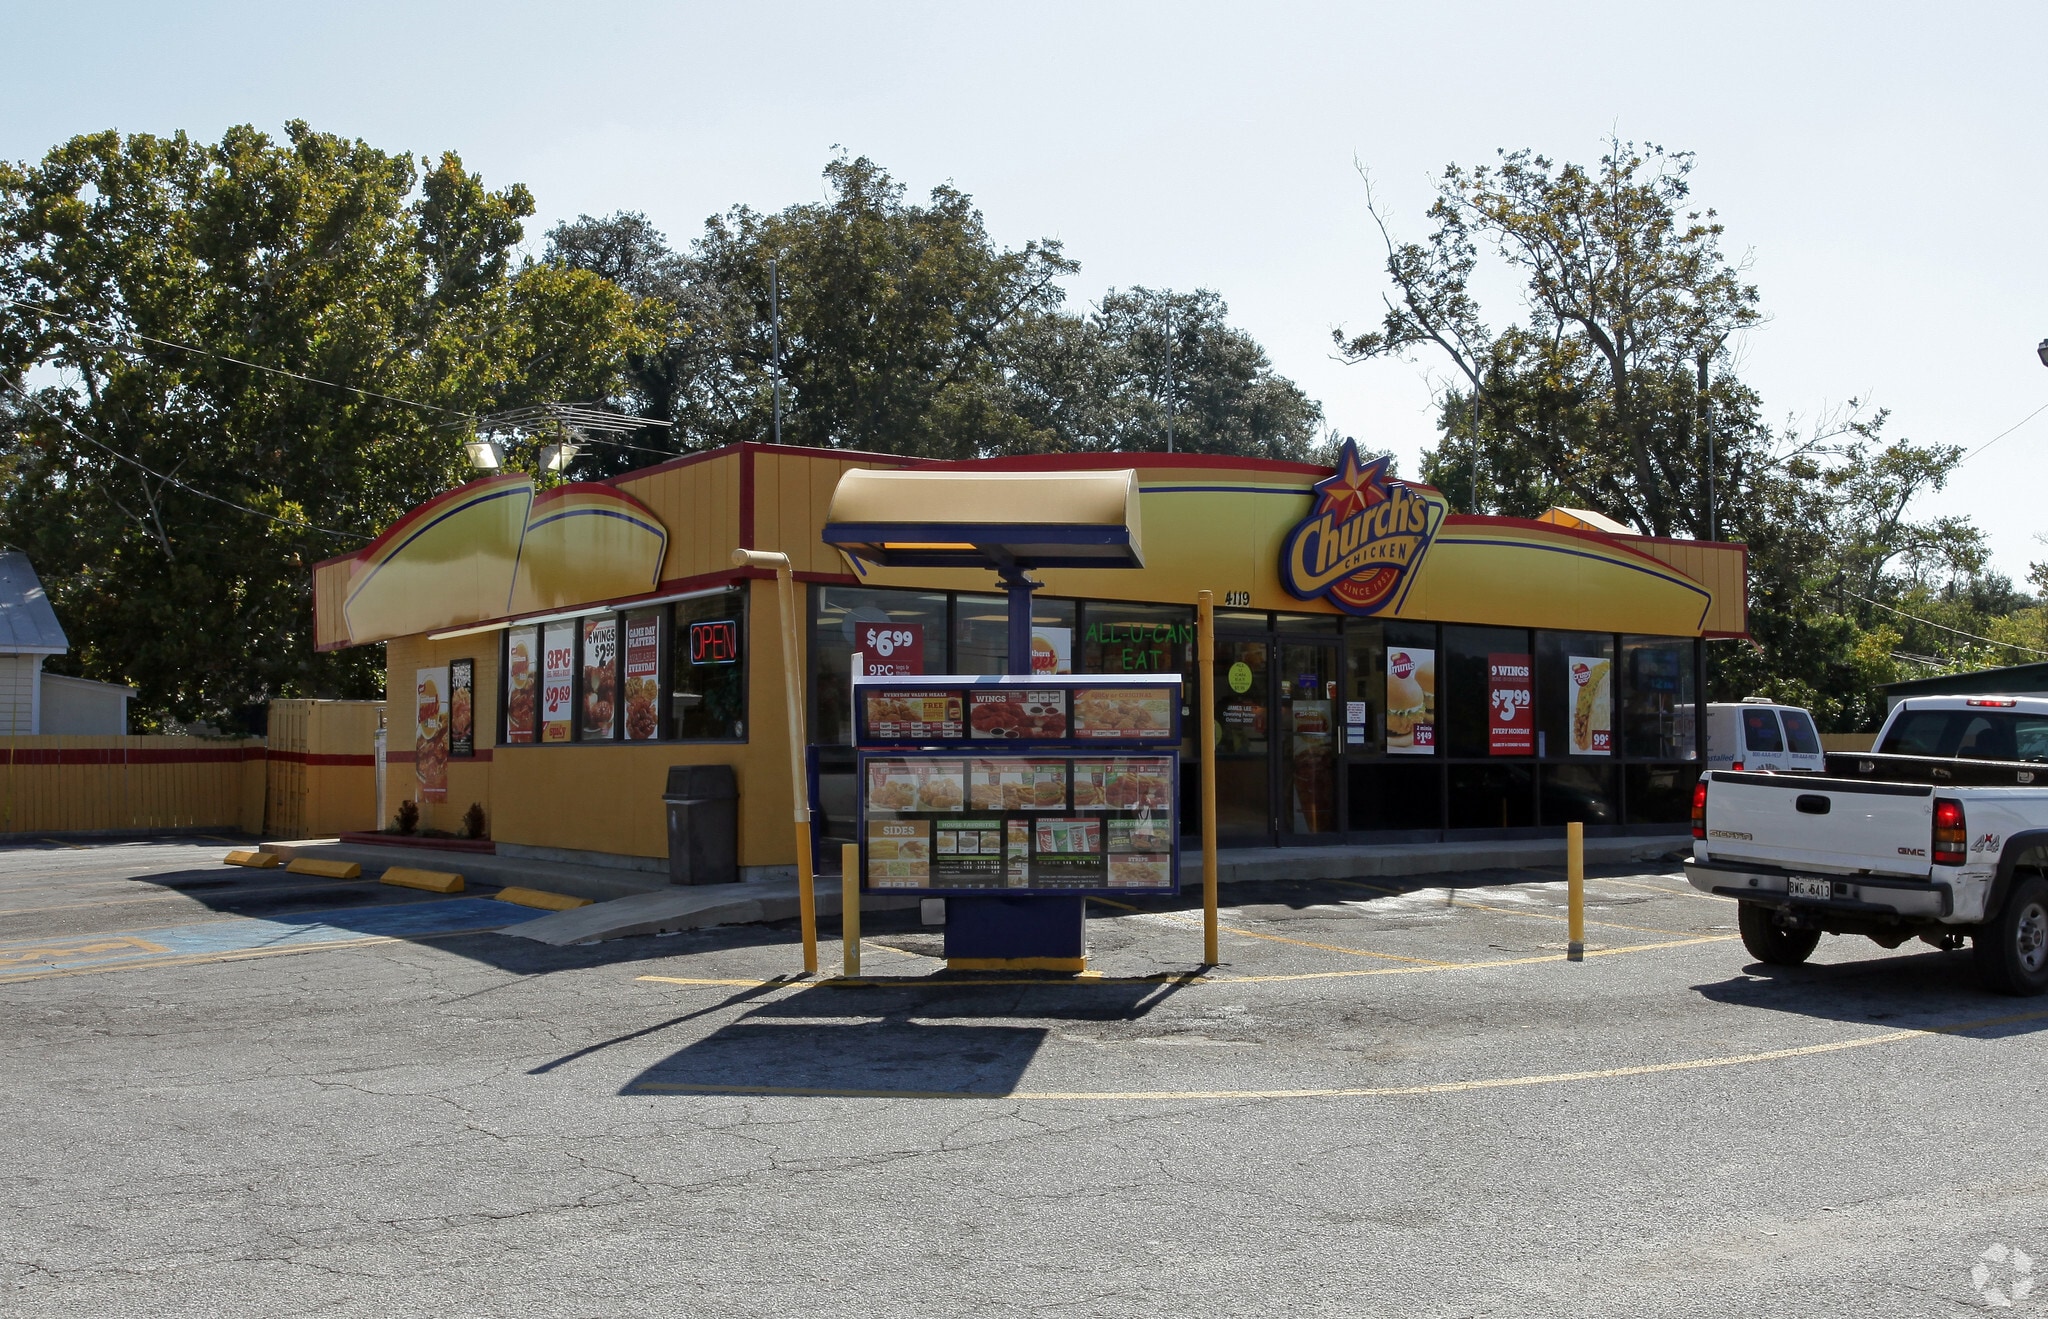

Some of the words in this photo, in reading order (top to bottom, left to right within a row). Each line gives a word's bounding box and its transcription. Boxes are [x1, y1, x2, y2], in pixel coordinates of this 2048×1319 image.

[1291, 487, 1426, 592] Church's
[1344, 543, 1407, 569] CHICKEN
[1343, 582, 1370, 596] SINCE
[1373, 571, 1391, 590] 1952
[1225, 591, 1250, 606] 4119
[592, 628, 616, 644] WINGS
[628, 627, 645, 639] GAME
[645, 625, 656, 637] DAY
[1085, 622, 1195, 645] ALL-U-CAN
[628, 635, 656, 648] PLATTERS
[692, 624, 736, 661] OPEN
[547, 648, 571, 670] 3PC
[1122, 648, 1163, 671] EAT
[628, 661, 656, 673] EVERYDAY
[869, 664, 894, 676] 9PC
[1491, 665, 1497, 676] 9
[1497, 665, 1529, 677] WINGS
[976, 695, 1007, 703] WINGS
[883, 826, 915, 835] SIDES
[1897, 847, 1926, 857] GMC
